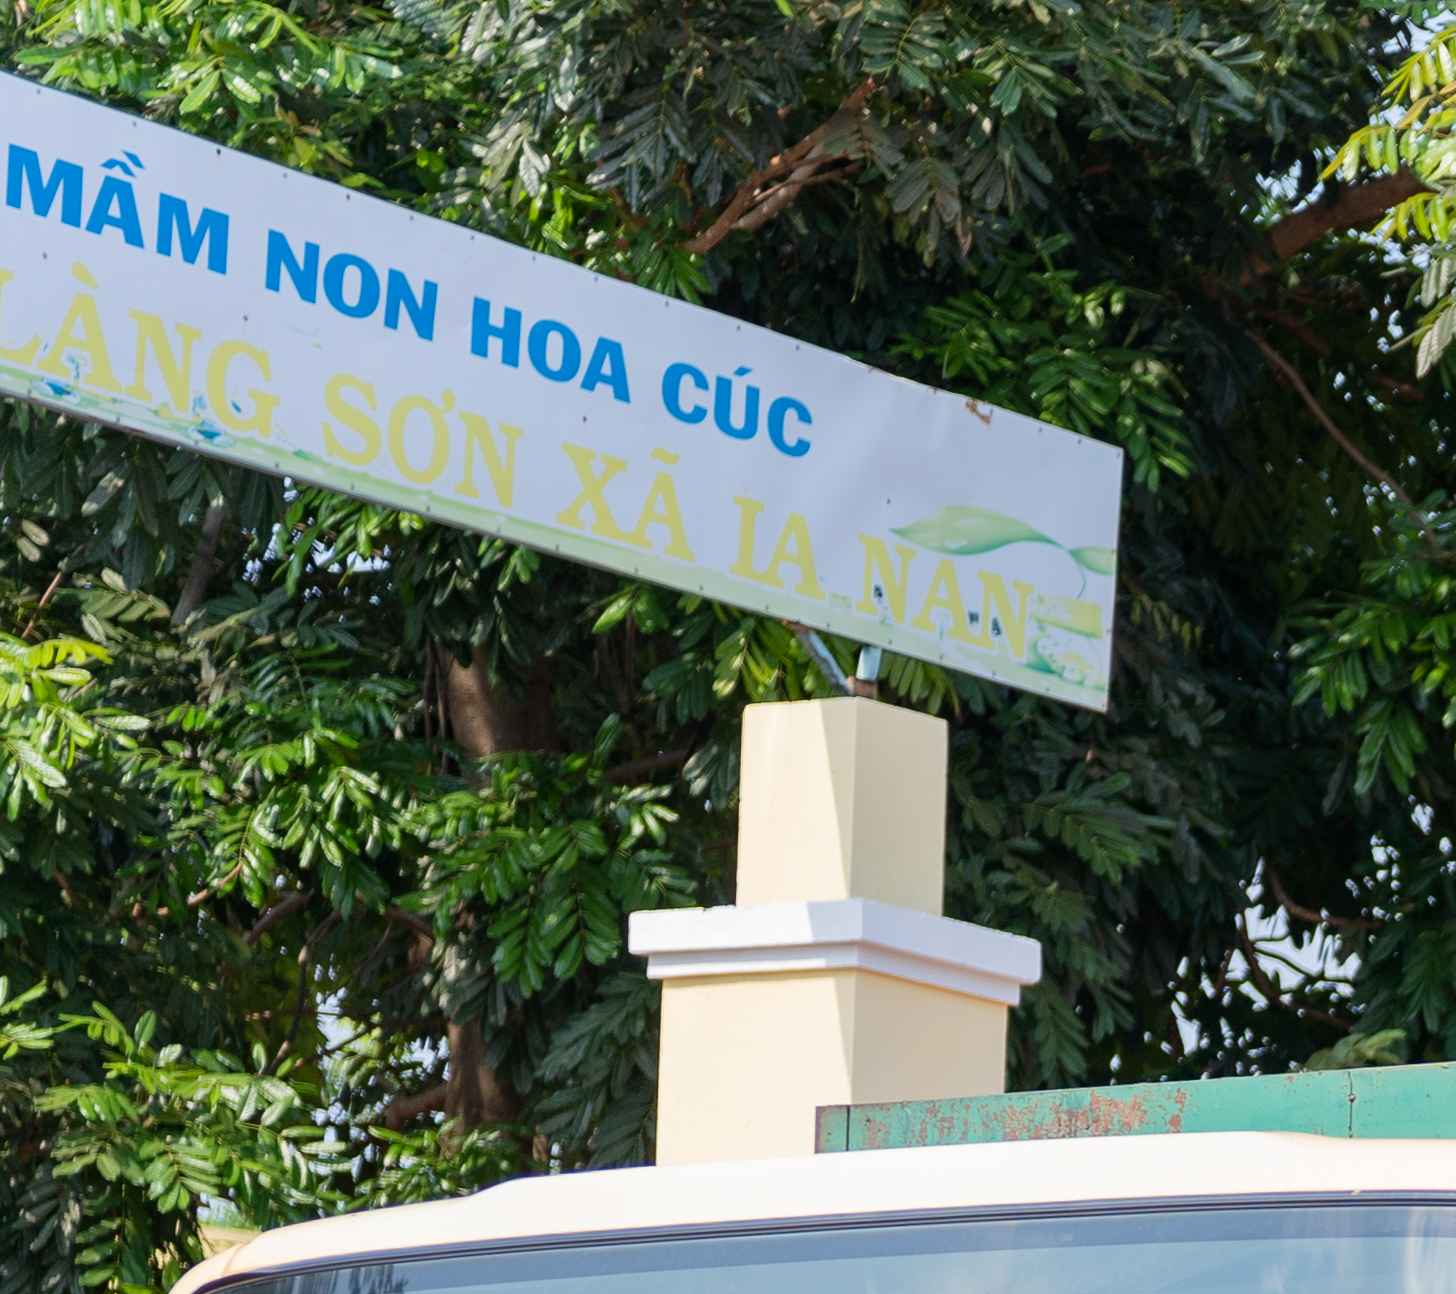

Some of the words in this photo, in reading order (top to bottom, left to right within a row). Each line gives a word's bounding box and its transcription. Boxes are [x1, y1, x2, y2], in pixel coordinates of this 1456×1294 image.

[6, 143, 230, 275] MẦM
[265, 229, 438, 342] NON
[470, 296, 631, 404] HOA
[661, 362, 813, 457] CÚC
[321, 373, 524, 509] SƠN
[554, 441, 695, 562] XÃ
[730, 496, 826, 599] IA
[855, 531, 1035, 659] NAN
